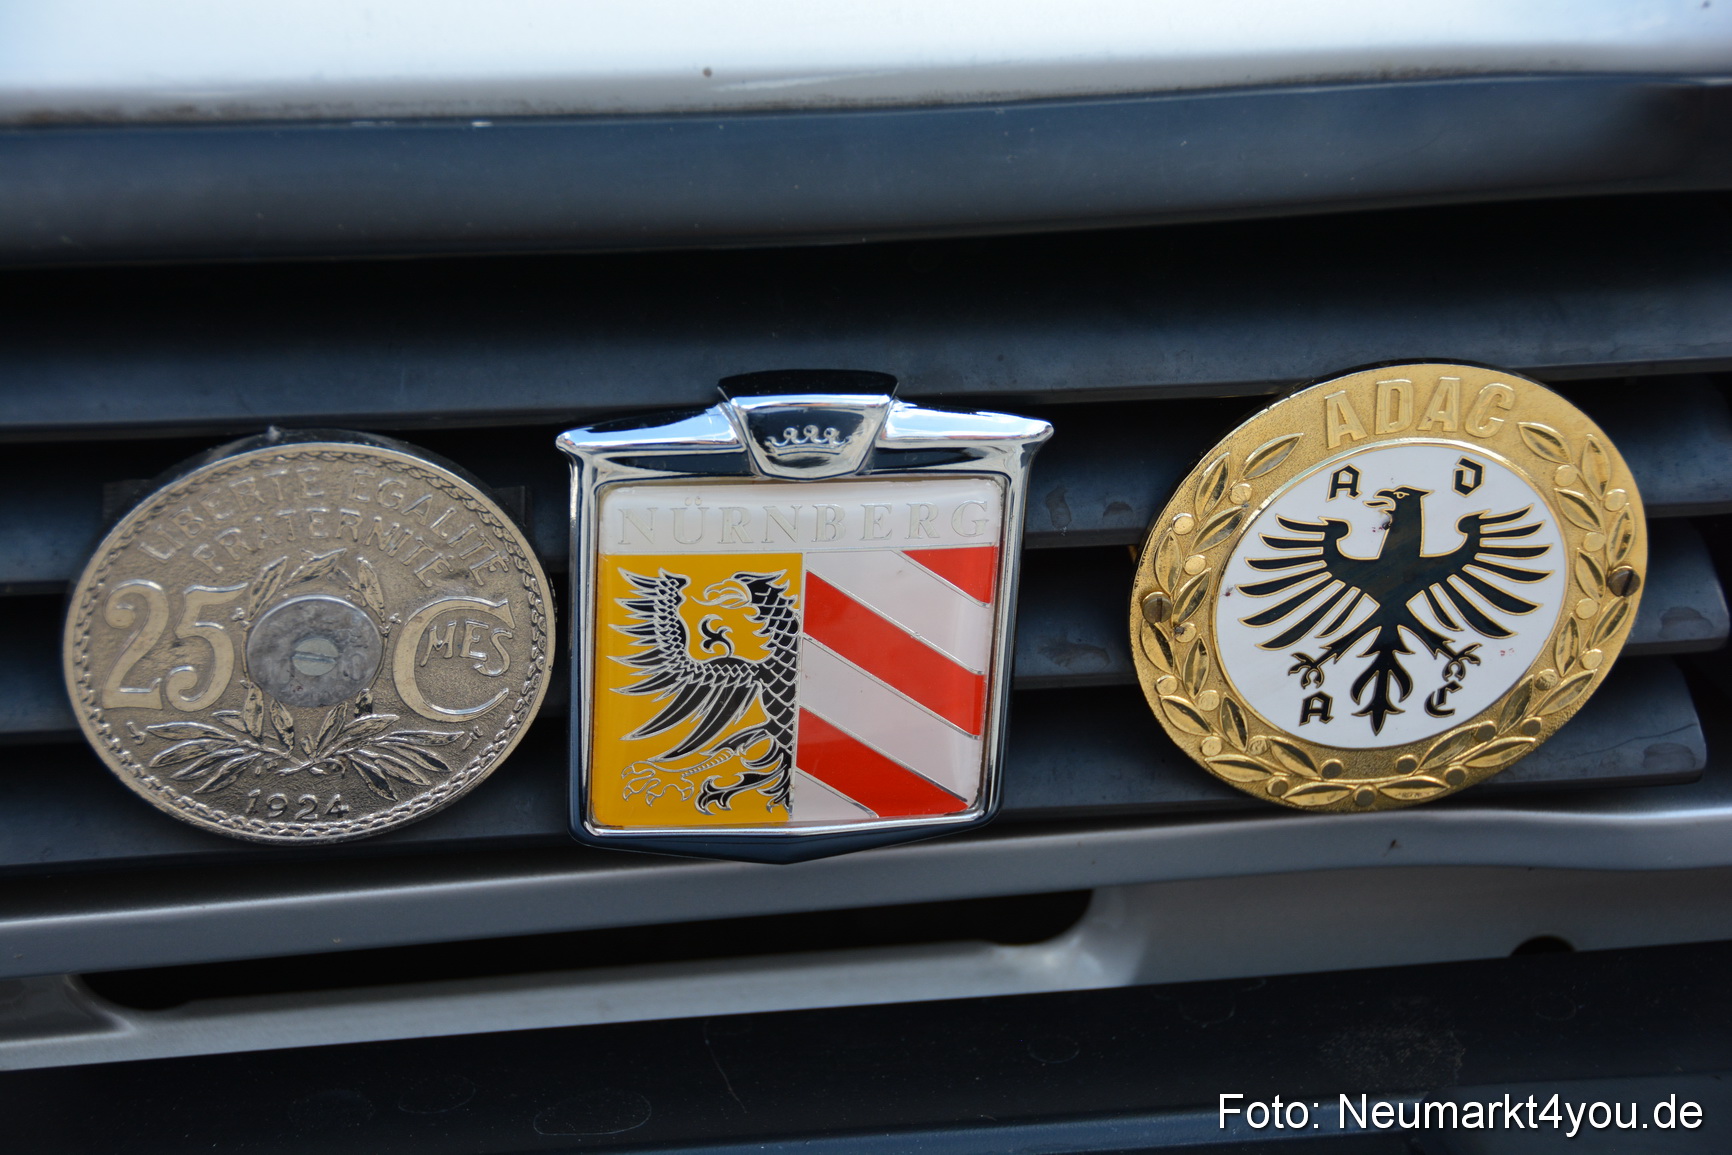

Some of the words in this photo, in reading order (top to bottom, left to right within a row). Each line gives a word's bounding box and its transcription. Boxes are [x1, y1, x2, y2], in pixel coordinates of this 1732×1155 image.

[1324, 376, 1516, 450] ADAC
[1326, 463, 1363, 502] A
[617, 496, 990, 546] NÜRNBERG
[102, 579, 249, 713] 25
[1299, 690, 1334, 726] A
[246, 788, 350, 821] 1924
